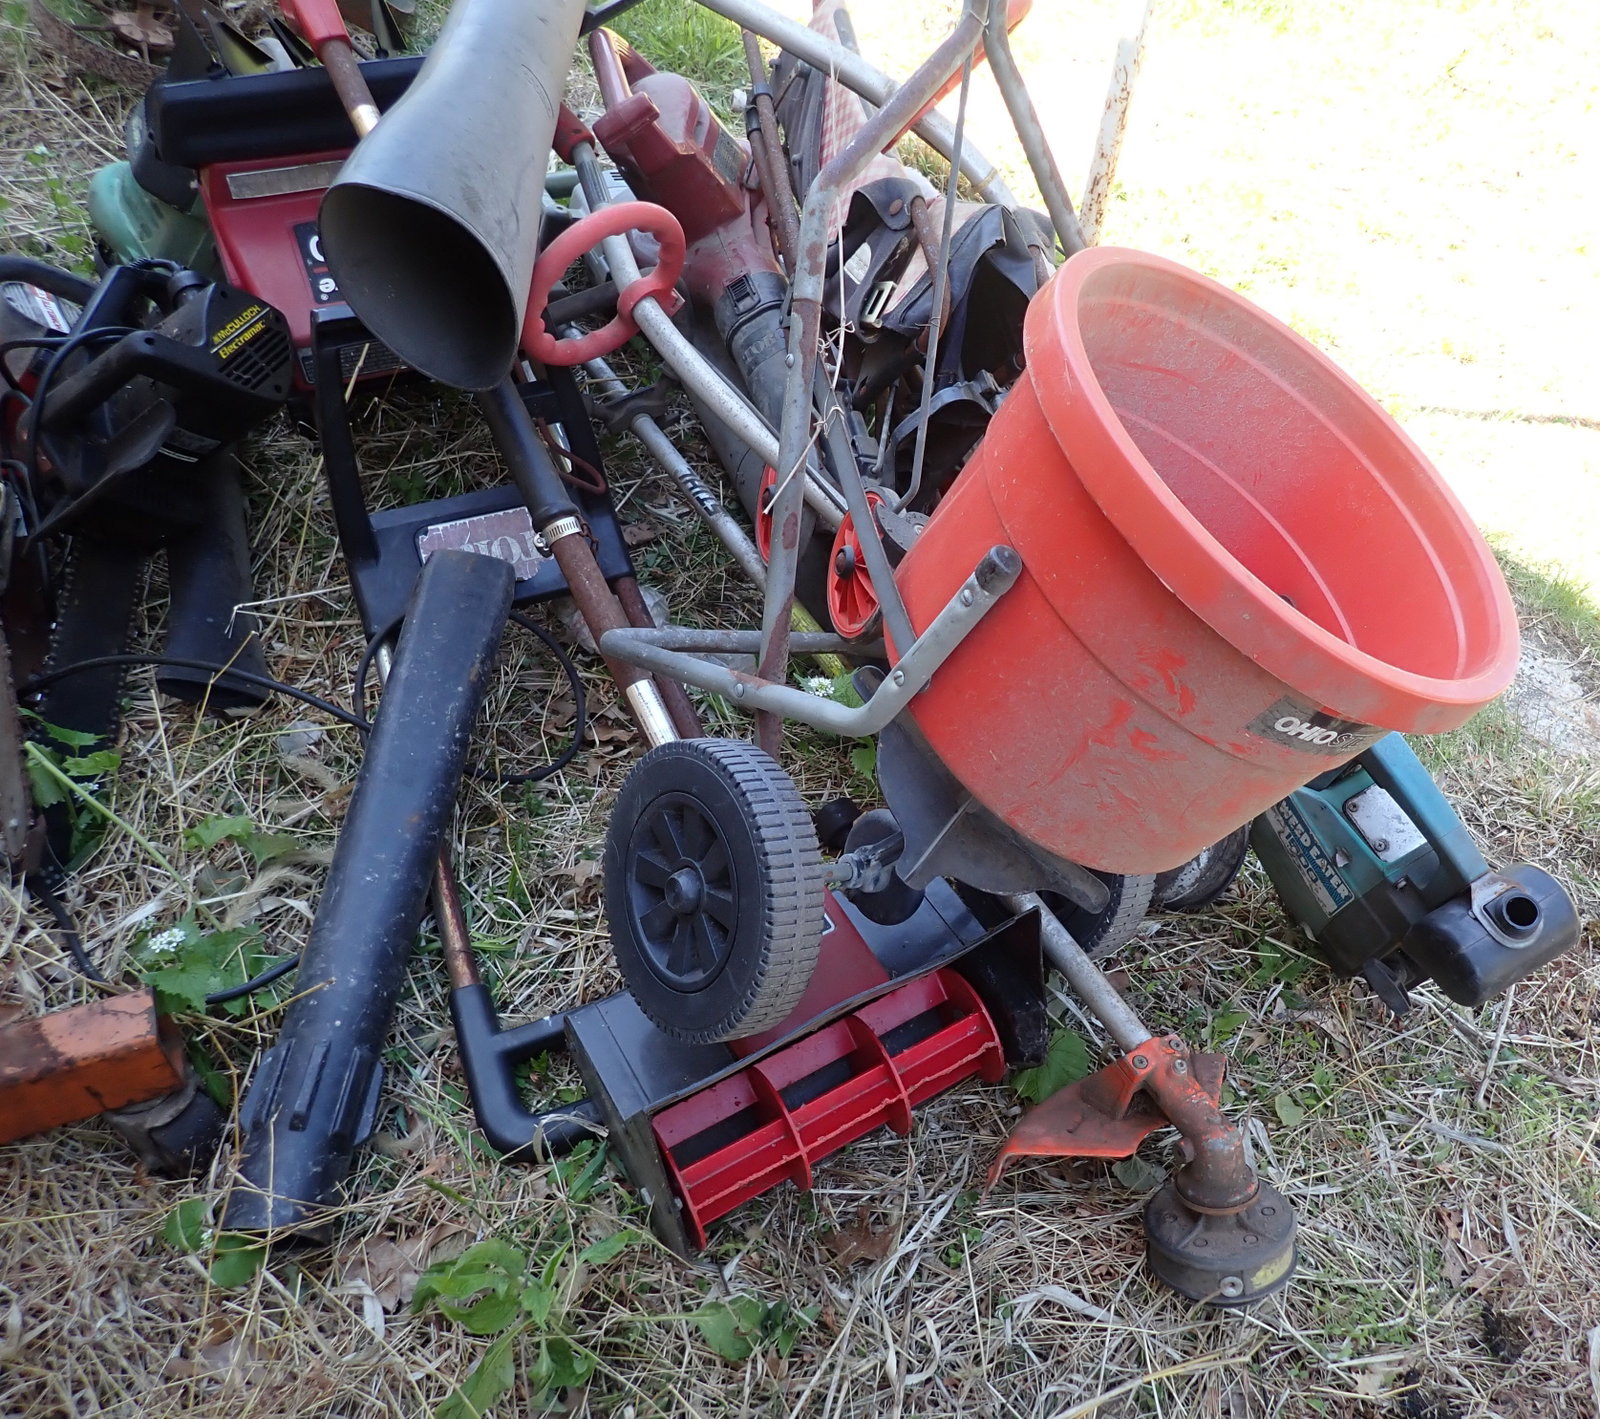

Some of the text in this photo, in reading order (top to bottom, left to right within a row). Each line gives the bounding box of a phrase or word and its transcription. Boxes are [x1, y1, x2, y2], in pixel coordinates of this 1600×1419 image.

[216, 304, 262, 342] McCULLOCH
[1274, 716, 1338, 745] OHIO
[1280, 800, 1349, 899] WEED EATER
